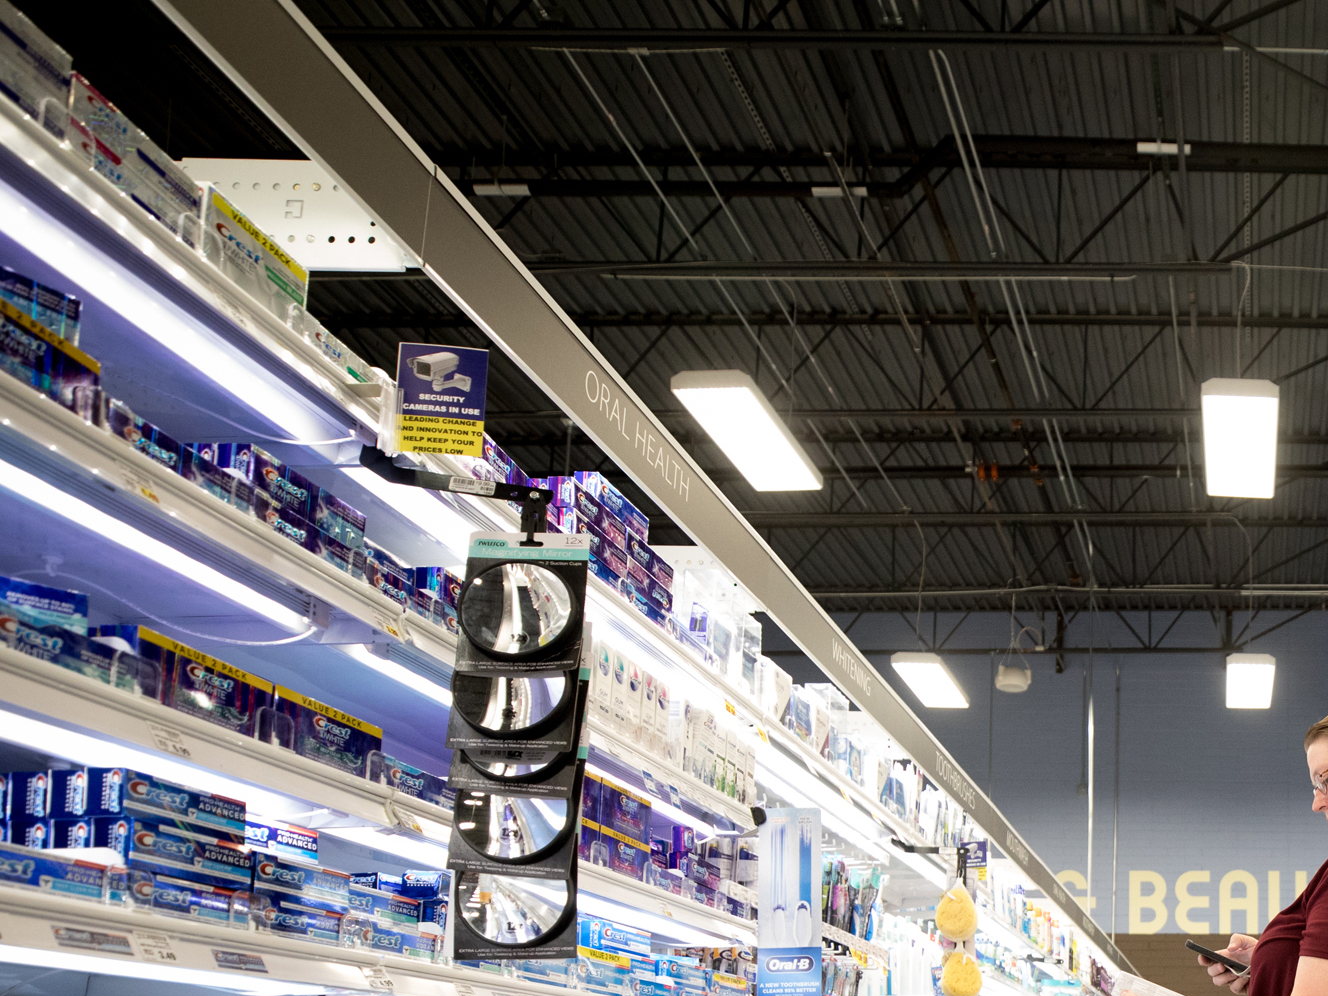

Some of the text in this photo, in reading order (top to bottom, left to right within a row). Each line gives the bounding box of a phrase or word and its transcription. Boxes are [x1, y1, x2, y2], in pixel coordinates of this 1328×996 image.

[216, 222, 260, 265] Crest
[419, 393, 465, 403] SECURITY
[403, 403, 447, 412] CAMERAS
[449, 406, 459, 414] IN
[416, 426, 469, 436] INNOVATION
[442, 419, 477, 427] CHANGE
[427, 436, 449, 444] KEEP
[585, 370, 690, 502] ORAL HEALTH
[482, 547, 573, 558] Magnifying Mirror
[171, 642, 247, 681] VALUE 2 PACK
[832, 638, 871, 697] WHITENING
[188, 663, 234, 692] Crest
[301, 696, 362, 729] VALUE 2 PACK
[314, 715, 351, 739] Crest
[128, 780, 189, 808] Crest
[199, 802, 245, 820] ADVANCED
[135, 831, 194, 857] Crest
[277, 835, 317, 851] ADVANCED
[205, 851, 250, 867] ADVANCED
[258, 862, 305, 883] Crest
[768, 958, 810, 970] Oral-B
